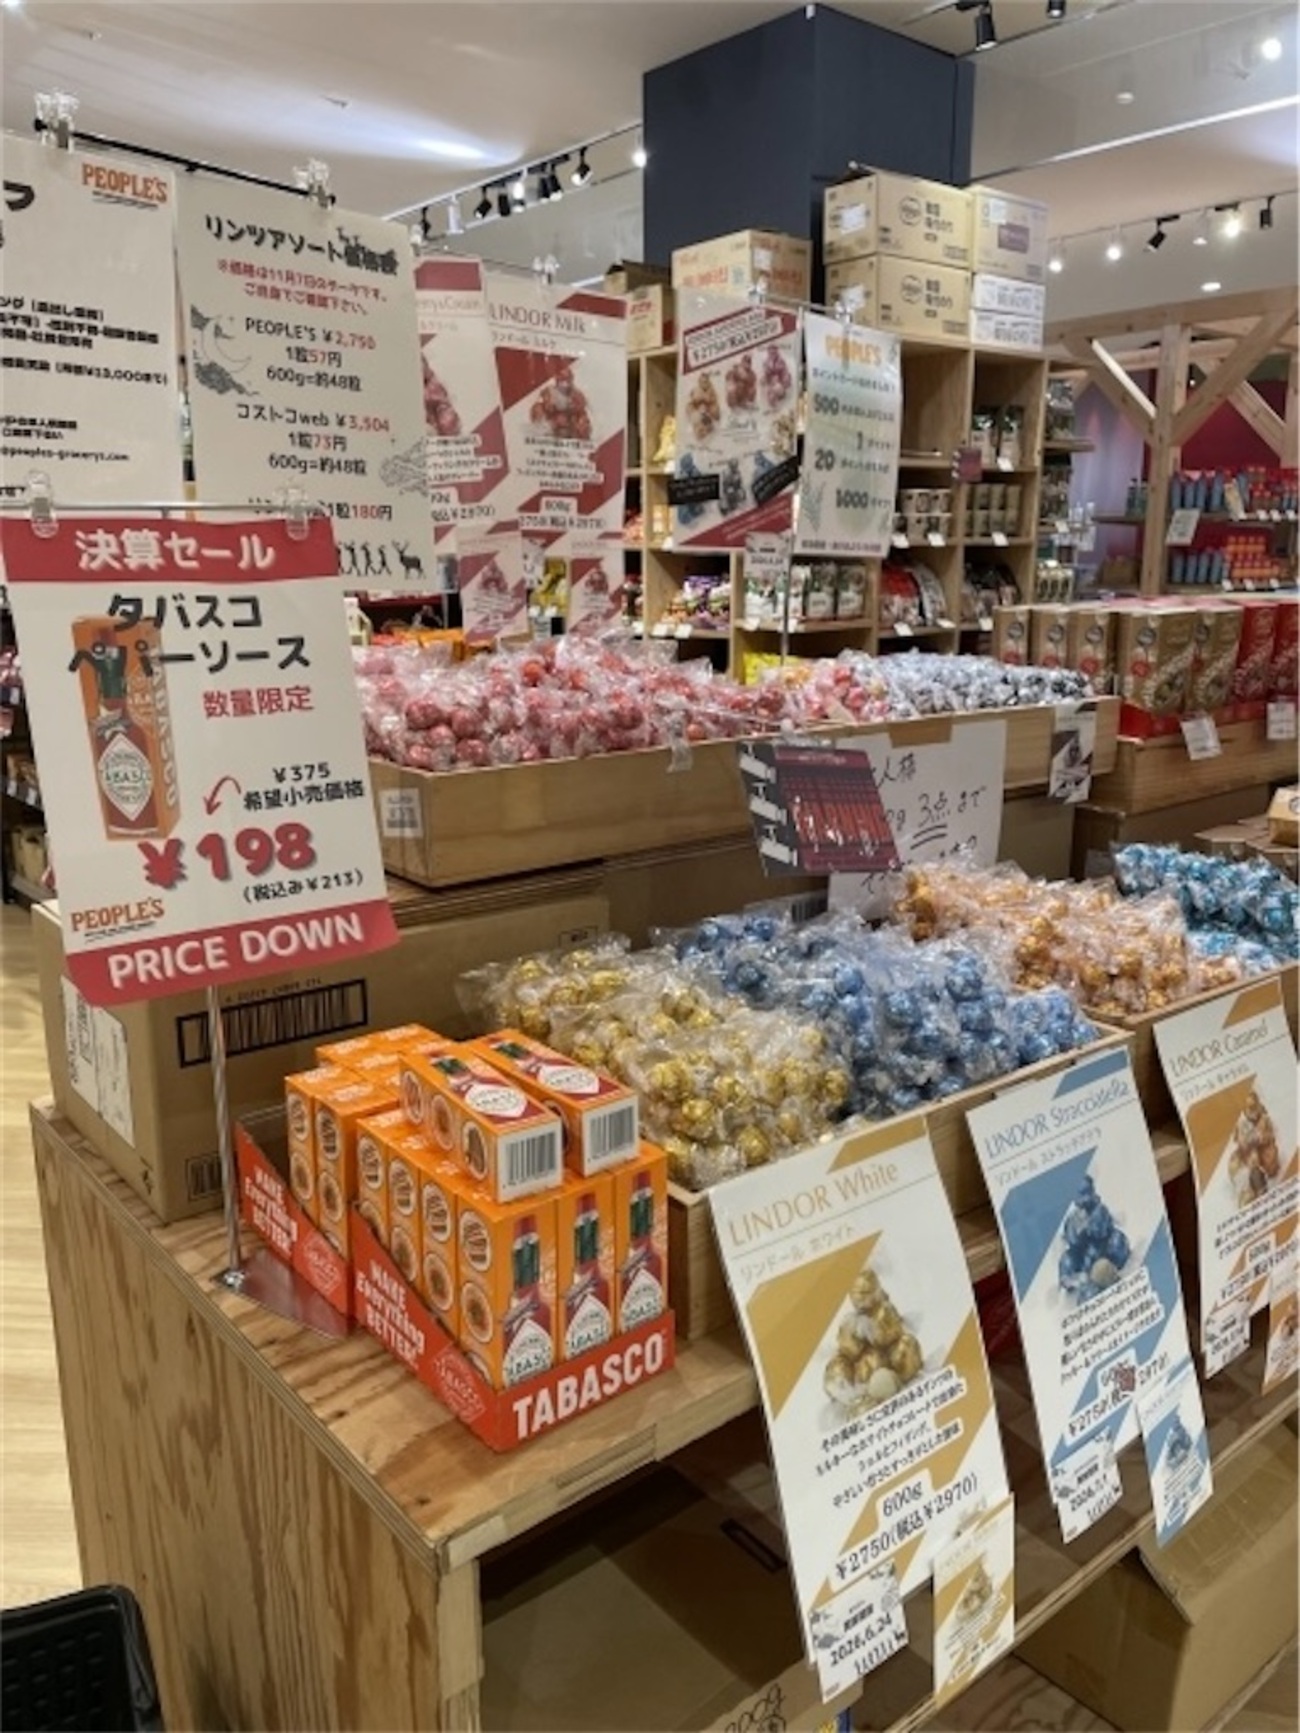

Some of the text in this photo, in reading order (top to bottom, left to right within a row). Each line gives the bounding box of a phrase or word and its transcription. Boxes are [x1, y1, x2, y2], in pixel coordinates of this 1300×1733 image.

[81, 163, 168, 203] PEOPLE'S
[246, 317, 316, 341] PEOPLE'S
[489, 303, 549, 328] LINDOR
[554, 312, 586, 334] Milk
[236, 403, 390, 432] コストコweb ¥3,504
[288, 431, 347, 451] 1粒73円
[815, 448, 835, 471] 20
[75, 527, 276, 572] 決算セール
[107, 593, 263, 632] タバスコ
[203, 685, 315, 720] 数量限定
[273, 762, 331, 783] ¥375
[244, 780, 365, 811] 希望小売価格
[138, 822, 318, 890] ¥198
[243, 868, 364, 904] (税込み¥213)
[71, 897, 165, 933] PEOPLE'S
[108, 935, 230, 990] PRICE
[240, 911, 365, 963] DOWN
[985, 1112, 1051, 1160] LINDOR
[727, 1162, 899, 1247] LINDOR White
[740, 1224, 855, 1282] リンドール ホワイト
[513, 1331, 664, 1441] TABASCO
[882, 1481, 923, 1517] 600g
[835, 1472, 978, 1581] ¥2750(税込¥2970)
